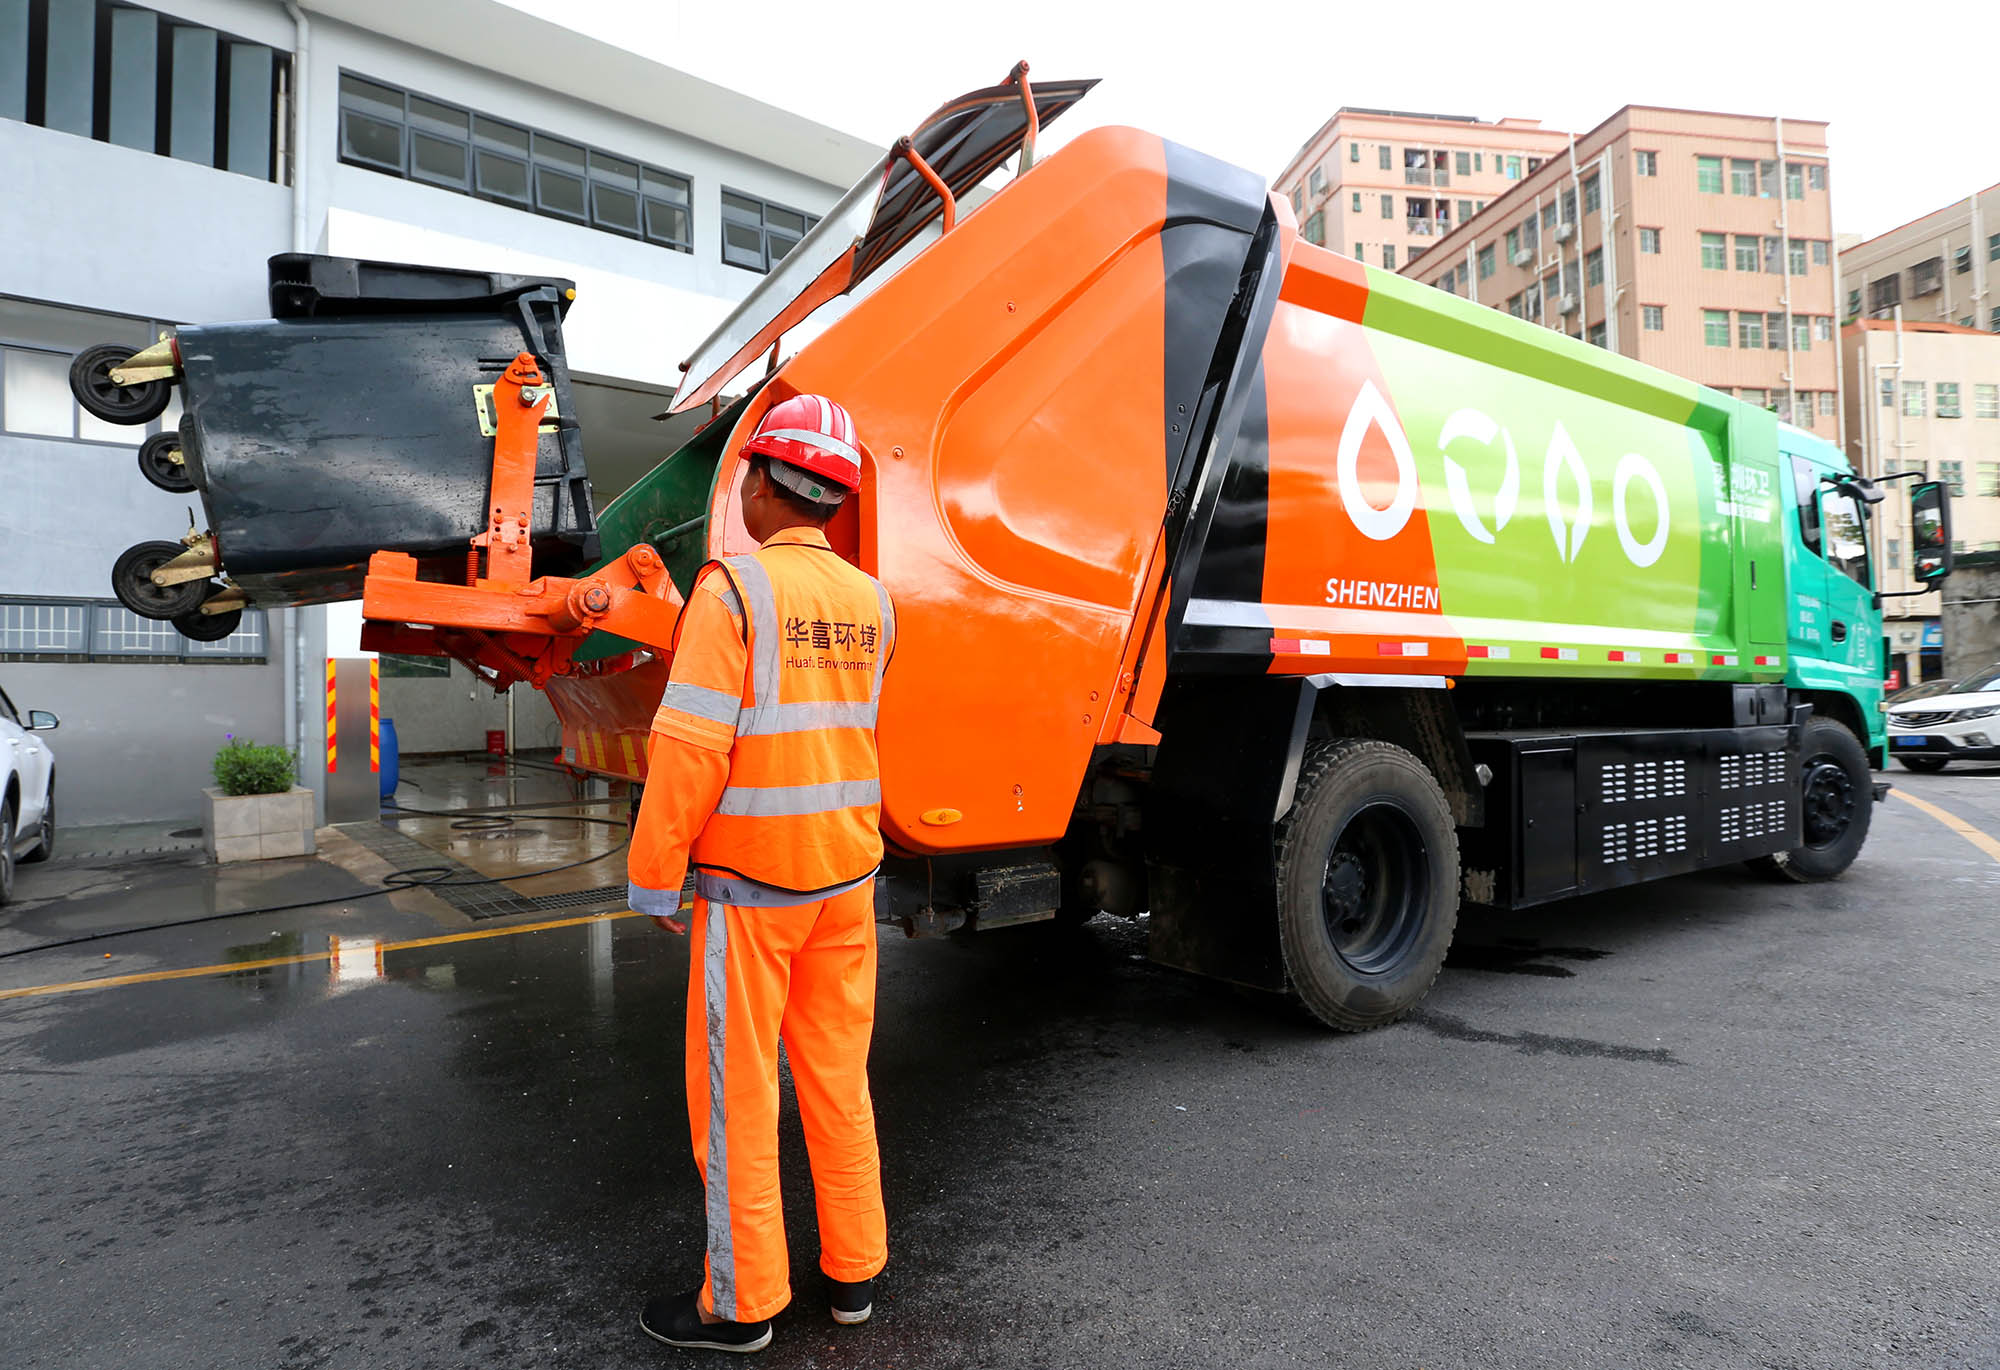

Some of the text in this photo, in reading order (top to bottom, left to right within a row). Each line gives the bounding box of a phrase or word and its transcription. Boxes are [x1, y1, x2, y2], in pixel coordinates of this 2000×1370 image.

[1325, 577, 1439, 609] SHENZHEN
[785, 617, 877, 654] 华富环境
[817, 656, 873, 671] Environmt
